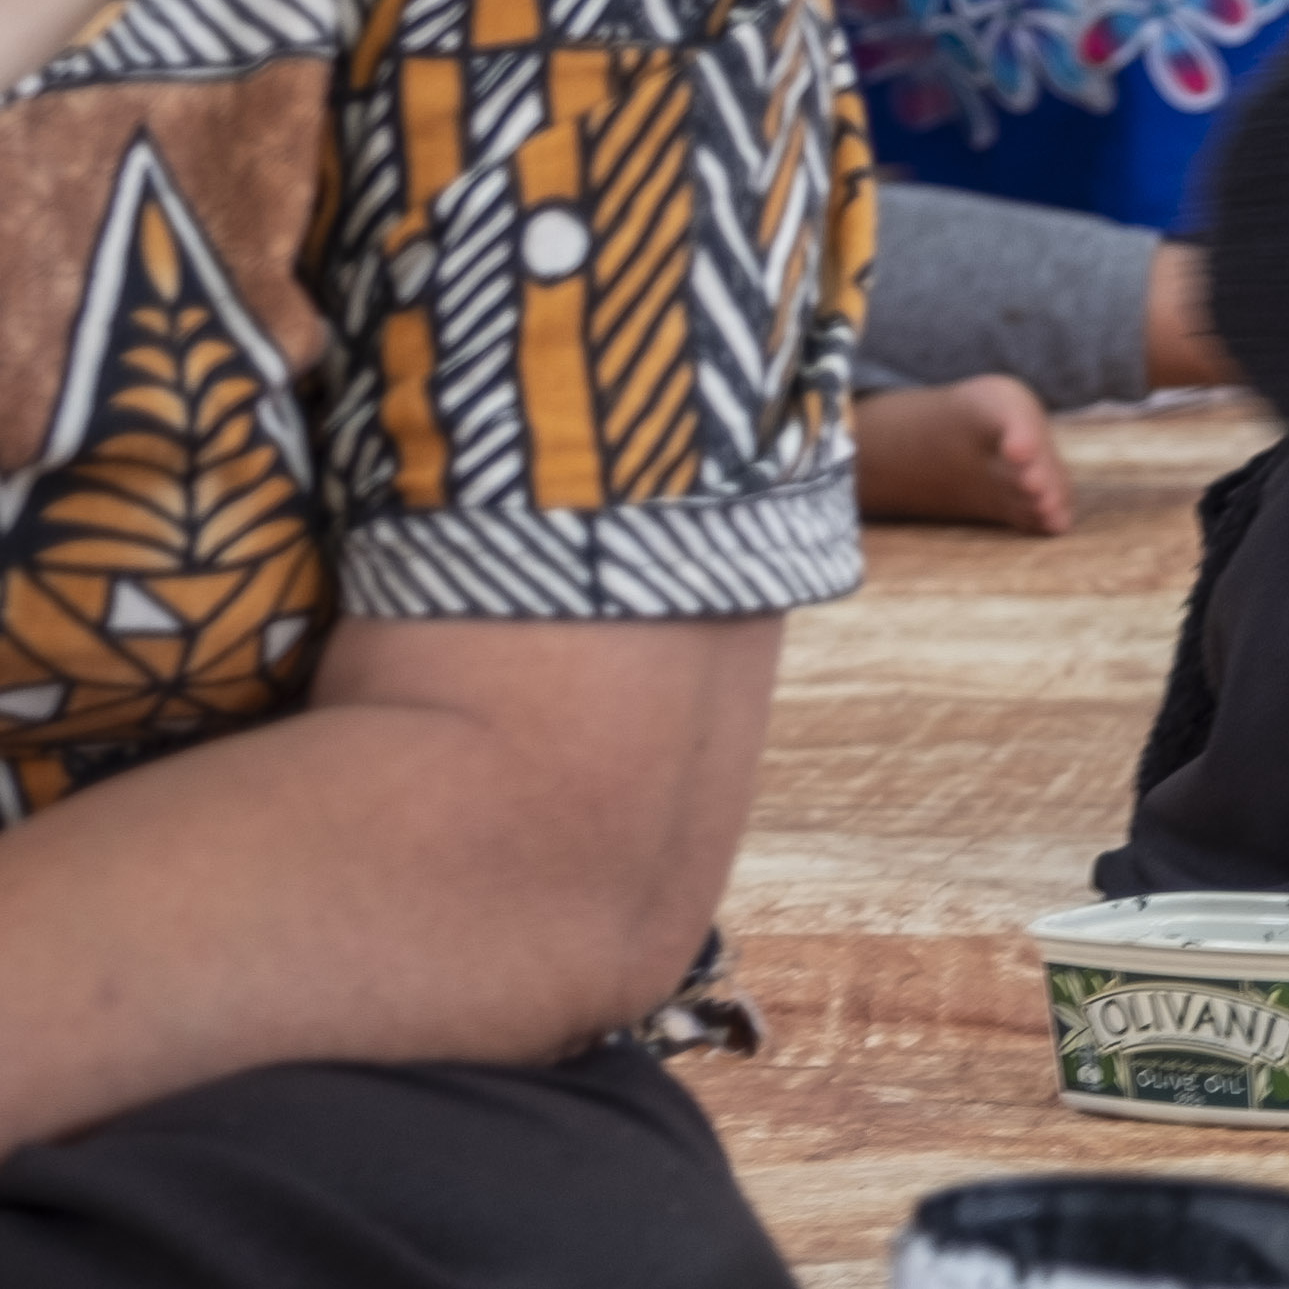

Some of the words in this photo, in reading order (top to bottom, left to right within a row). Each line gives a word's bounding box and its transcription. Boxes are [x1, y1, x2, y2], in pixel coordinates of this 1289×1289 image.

[1100, 990, 1280, 1057] OLIVANI
[1136, 1068, 1200, 1092] OLIVE
[1204, 1074, 1246, 1095] OIL
